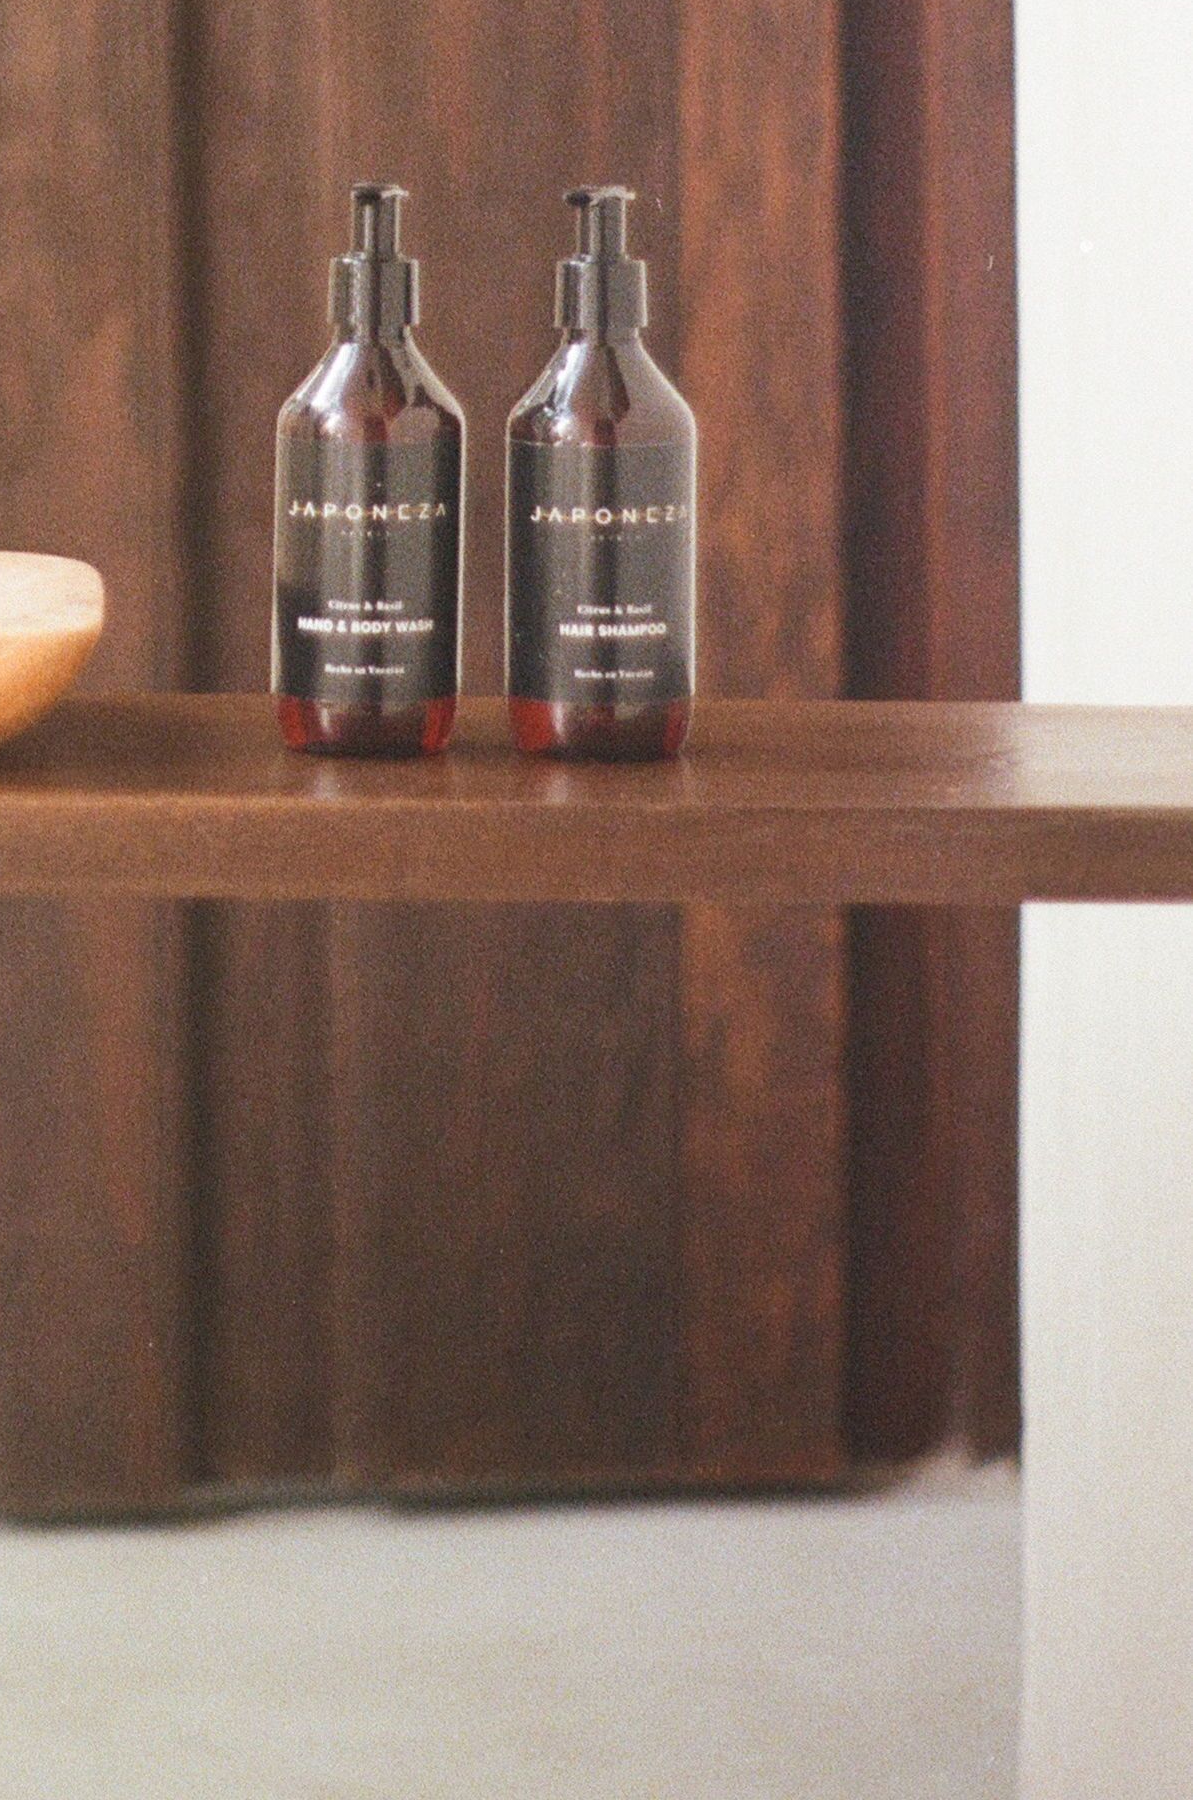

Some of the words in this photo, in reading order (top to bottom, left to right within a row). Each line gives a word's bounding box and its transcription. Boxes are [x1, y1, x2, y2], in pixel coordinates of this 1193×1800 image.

[288, 500, 446, 521] JAPONEZA
[298, 616, 333, 632] HAND
[337, 619, 347, 633] &
[351, 620, 391, 634] BODY
[395, 619, 434, 633] WASH
[559, 623, 594, 637] HAIR
[598, 623, 666, 637] SHAMPOO
